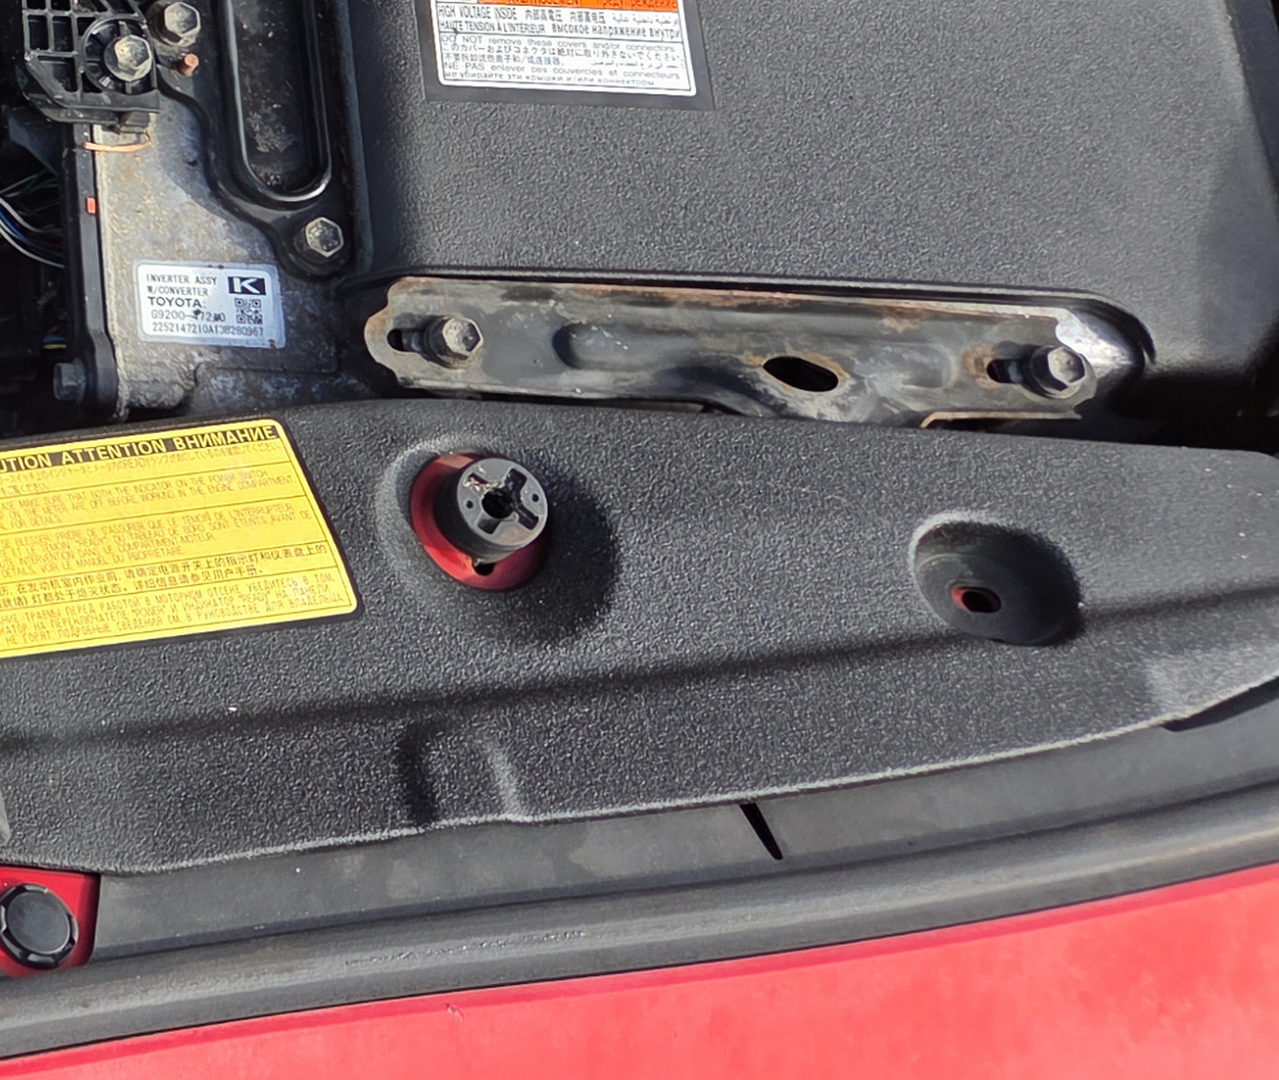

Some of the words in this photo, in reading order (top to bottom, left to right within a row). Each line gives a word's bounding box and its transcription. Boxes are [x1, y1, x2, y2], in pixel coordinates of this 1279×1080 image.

[438, 4, 456, 17] HIGH
[459, 5, 491, 18] VOLTAGE
[494, 7, 517, 19] INSIDE
[464, 20, 495, 31] TENSION
[462, 35, 483, 43] NOT
[488, 36, 521, 45] remove
[526, 38, 552, 46] these
[557, 40, 586, 48] covers
[464, 62, 484, 70] PAS
[490, 63, 525, 72] enlever
[146, 273, 189, 284] INVERTER
[193, 275, 217, 285] ASSY
[146, 285, 208, 295] W/CONVERTER
[147, 296, 201, 307] TOYOTA
[60, 440, 166, 463] ATTENTION
[172, 426, 277, 449] ВНИМАНИЕ
